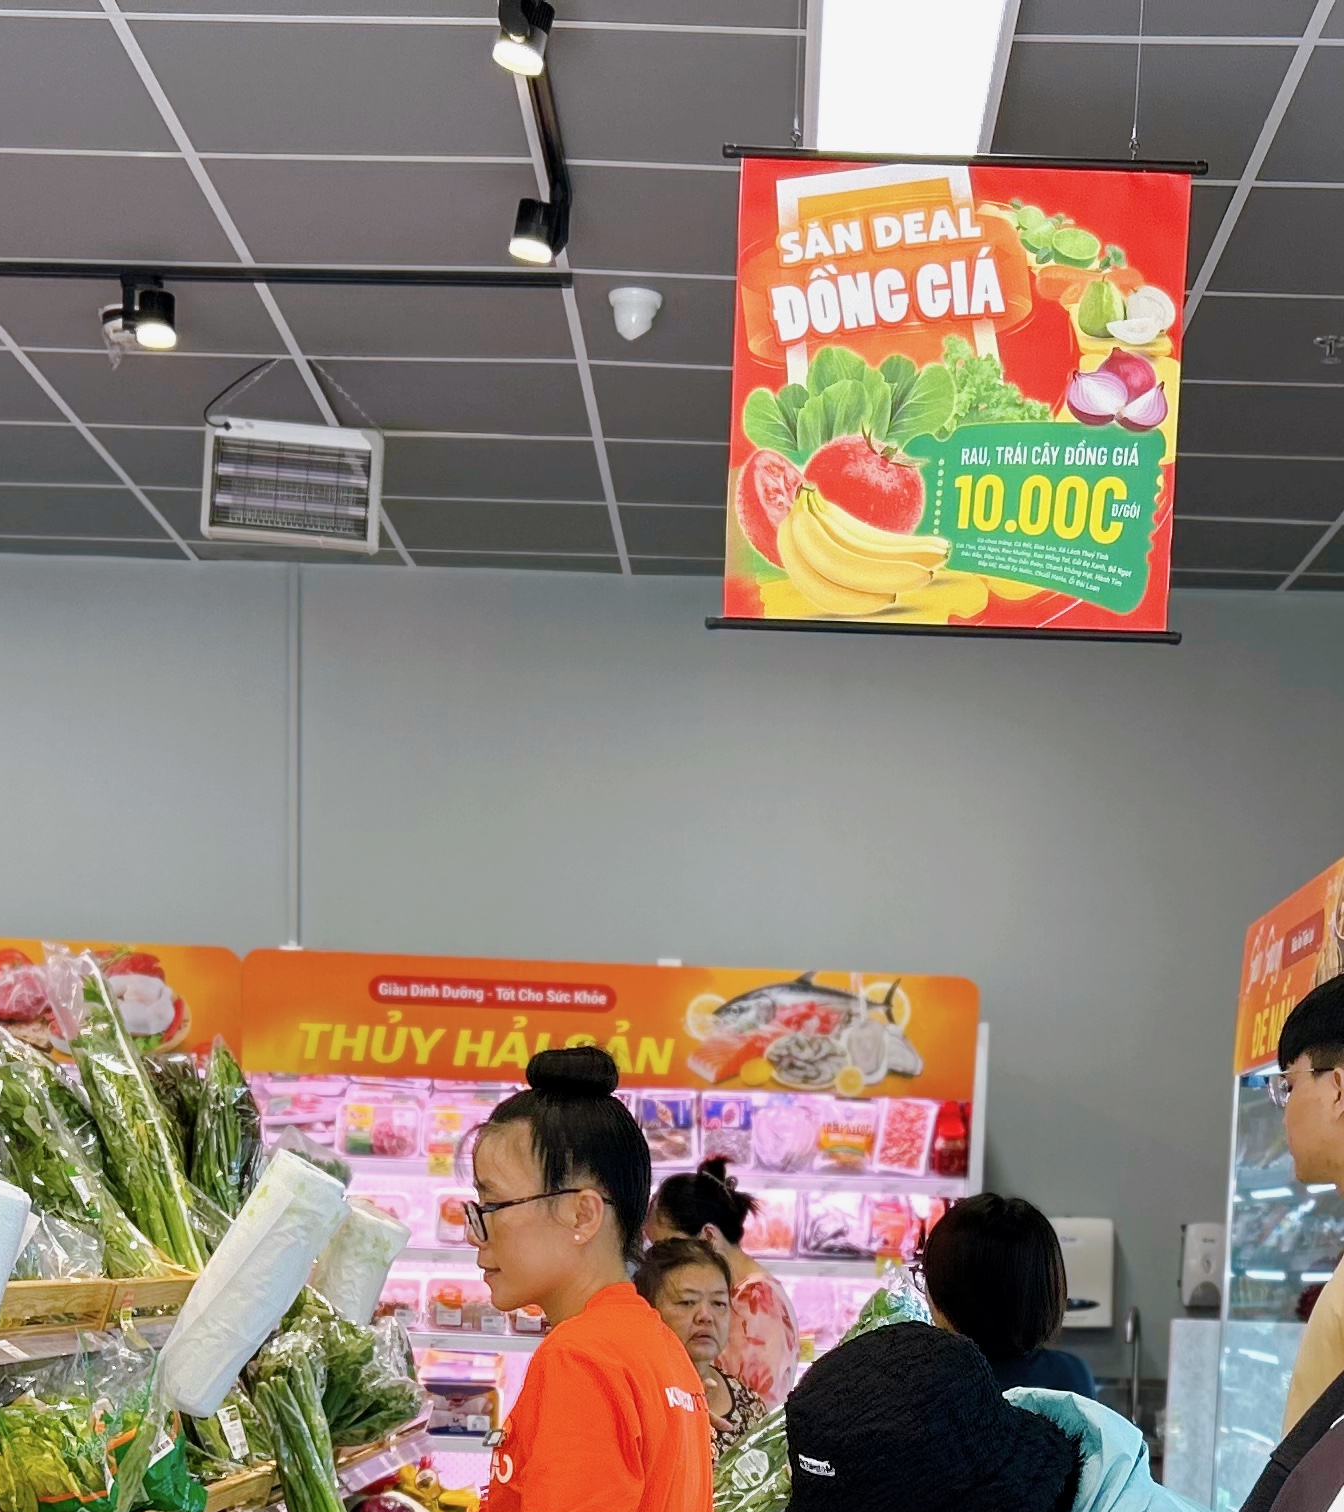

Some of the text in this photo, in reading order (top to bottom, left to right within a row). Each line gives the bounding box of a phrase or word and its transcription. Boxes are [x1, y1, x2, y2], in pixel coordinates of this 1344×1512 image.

[873, 207, 982, 249] DEAL
[771, 246, 1005, 343] ĐỒNG GIÁ
[960, 440, 1140, 467] RAU, TRÁI CÂY ĐỒNG GIÁ
[1110, 502, 1141, 519] Đ/GÓI
[378, 981, 408, 997] Giàu
[410, 982, 439, 998] Dinh
[442, 983, 485, 1002] Dưỡng
[496, 986, 516, 1001] Tốt
[518, 987, 544, 1002] Cho
[546, 987, 571, 1004] Sức
[298, 1010, 447, 1065] THỦY
[453, 1015, 551, 1069] HẢI
